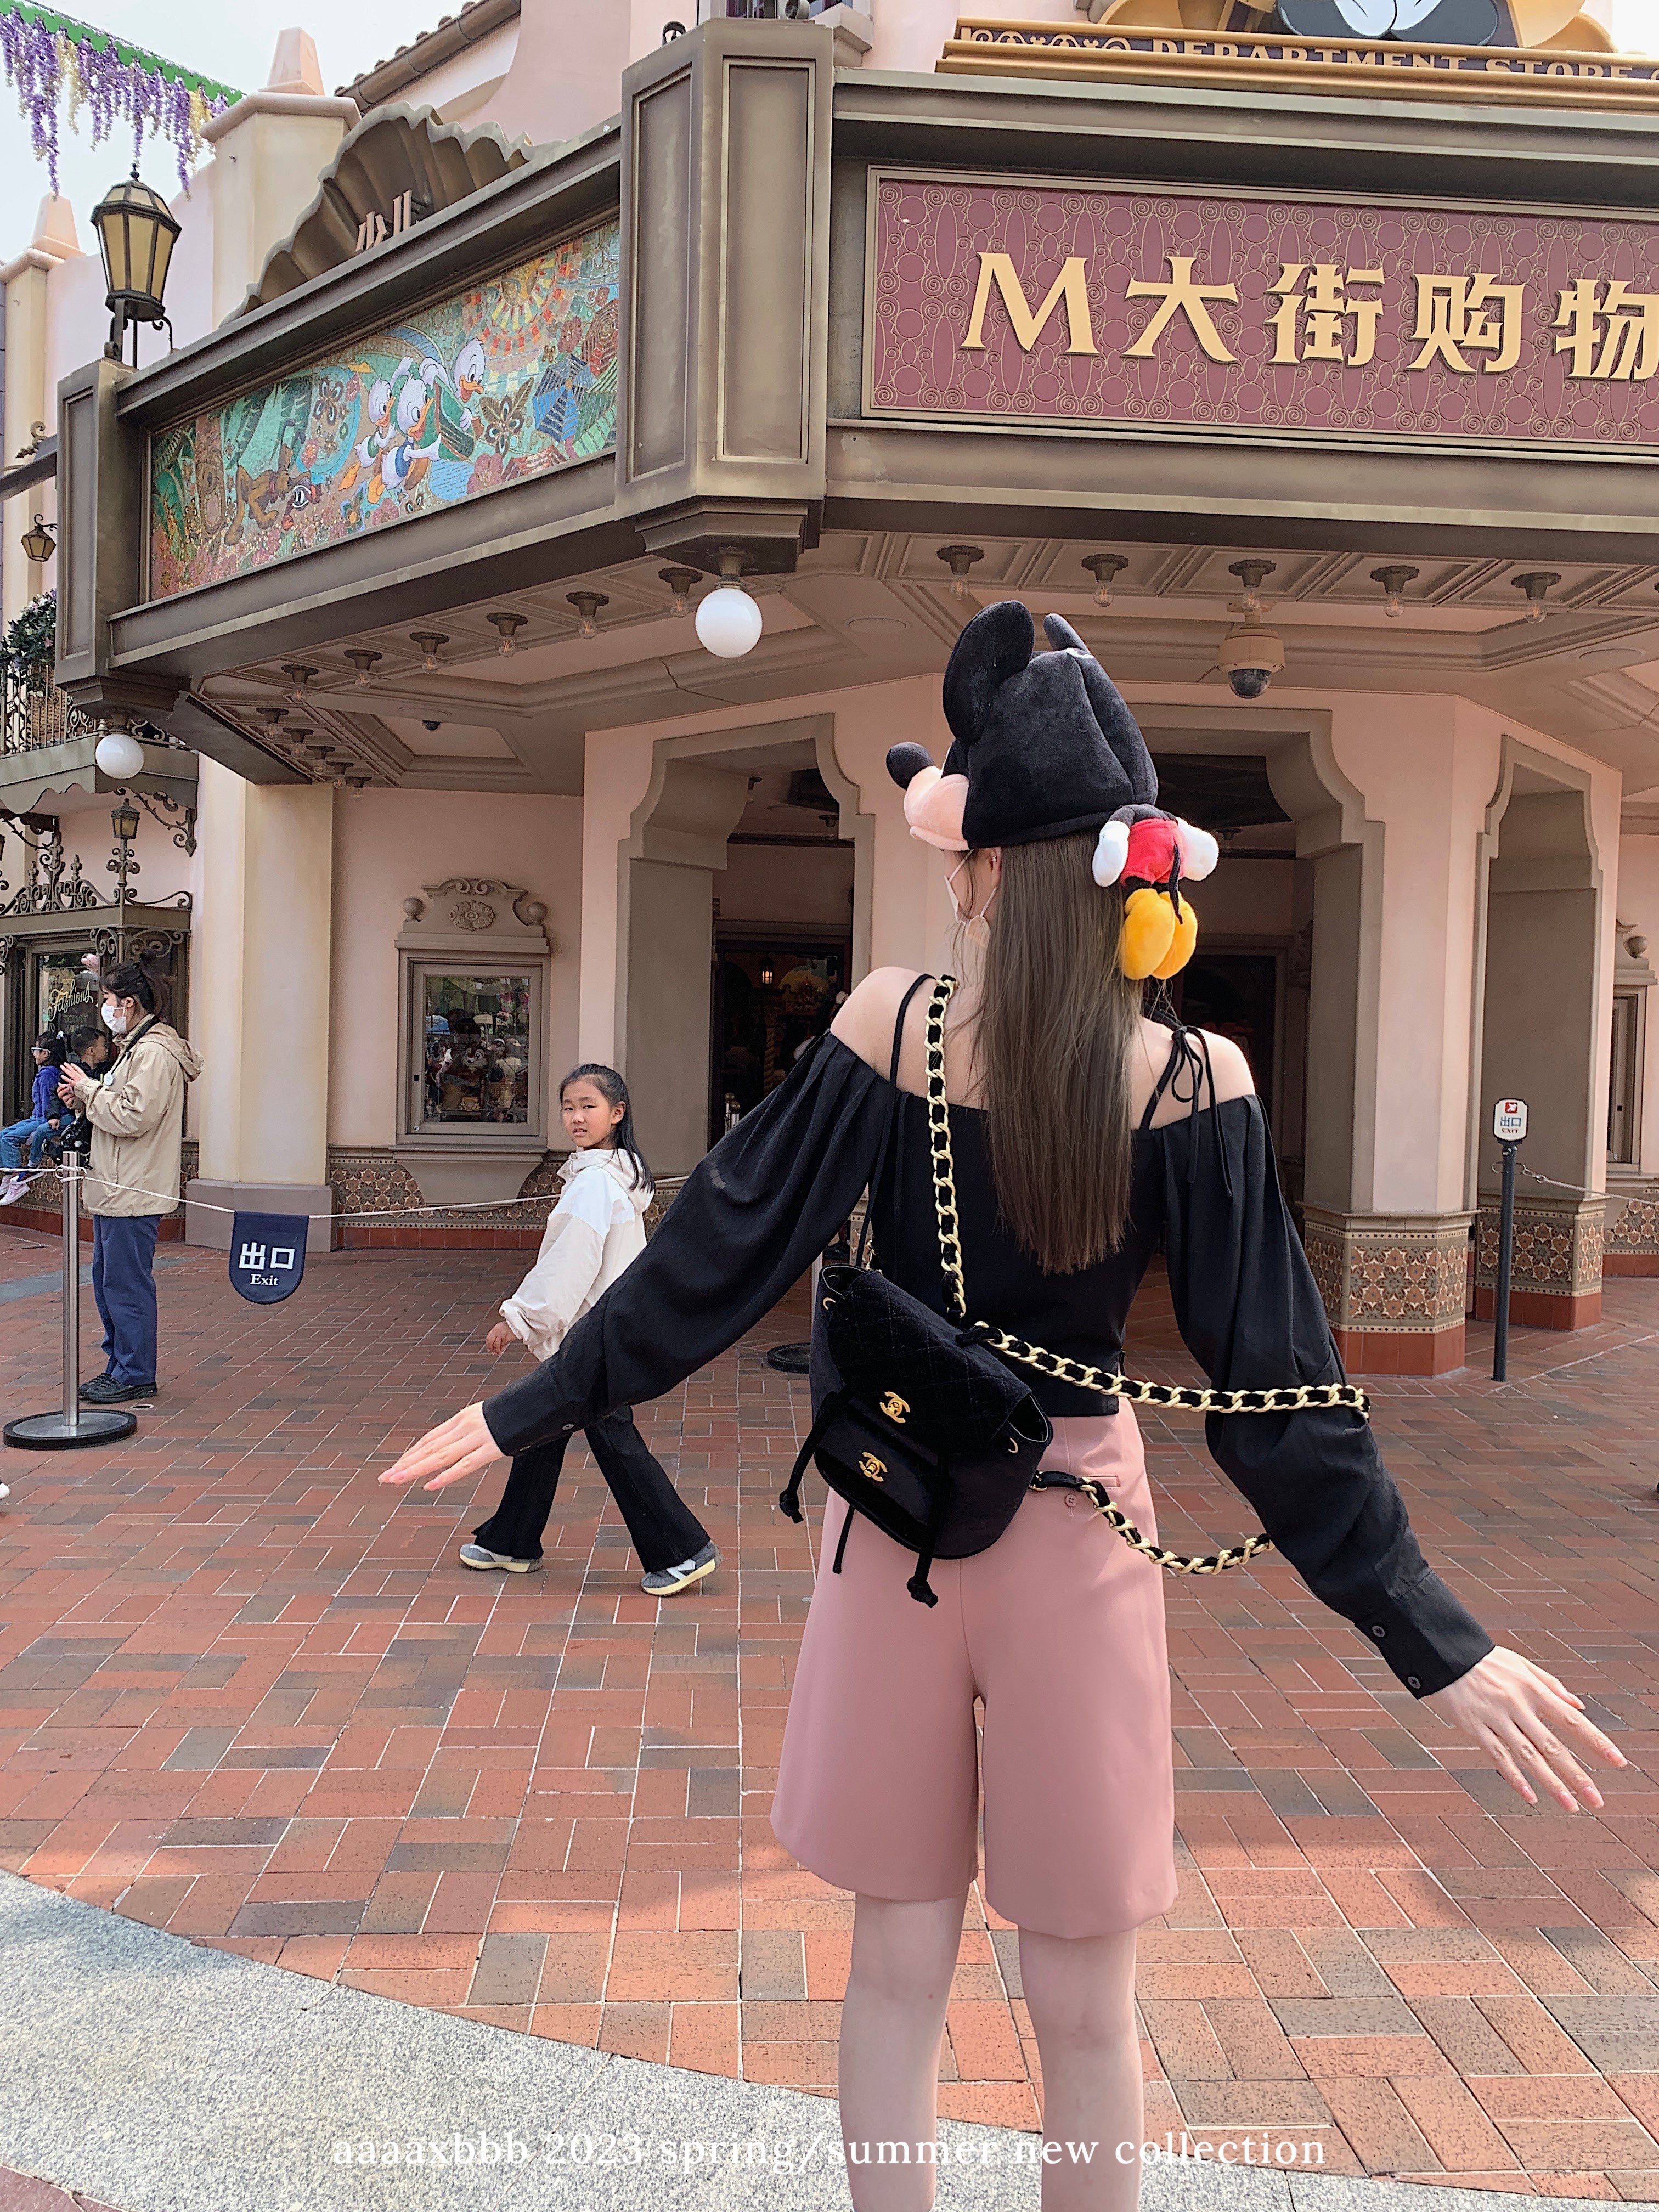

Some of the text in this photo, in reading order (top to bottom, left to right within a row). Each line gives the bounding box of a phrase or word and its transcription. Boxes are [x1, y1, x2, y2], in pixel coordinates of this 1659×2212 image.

[960, 251, 1659, 381] M大街购物
[47, 978, 94, 1022] Fashions
[1500, 1116, 1521, 1127] 出口
[239, 1242, 295, 1271] 出口
[250, 1273, 279, 1286] Exit
